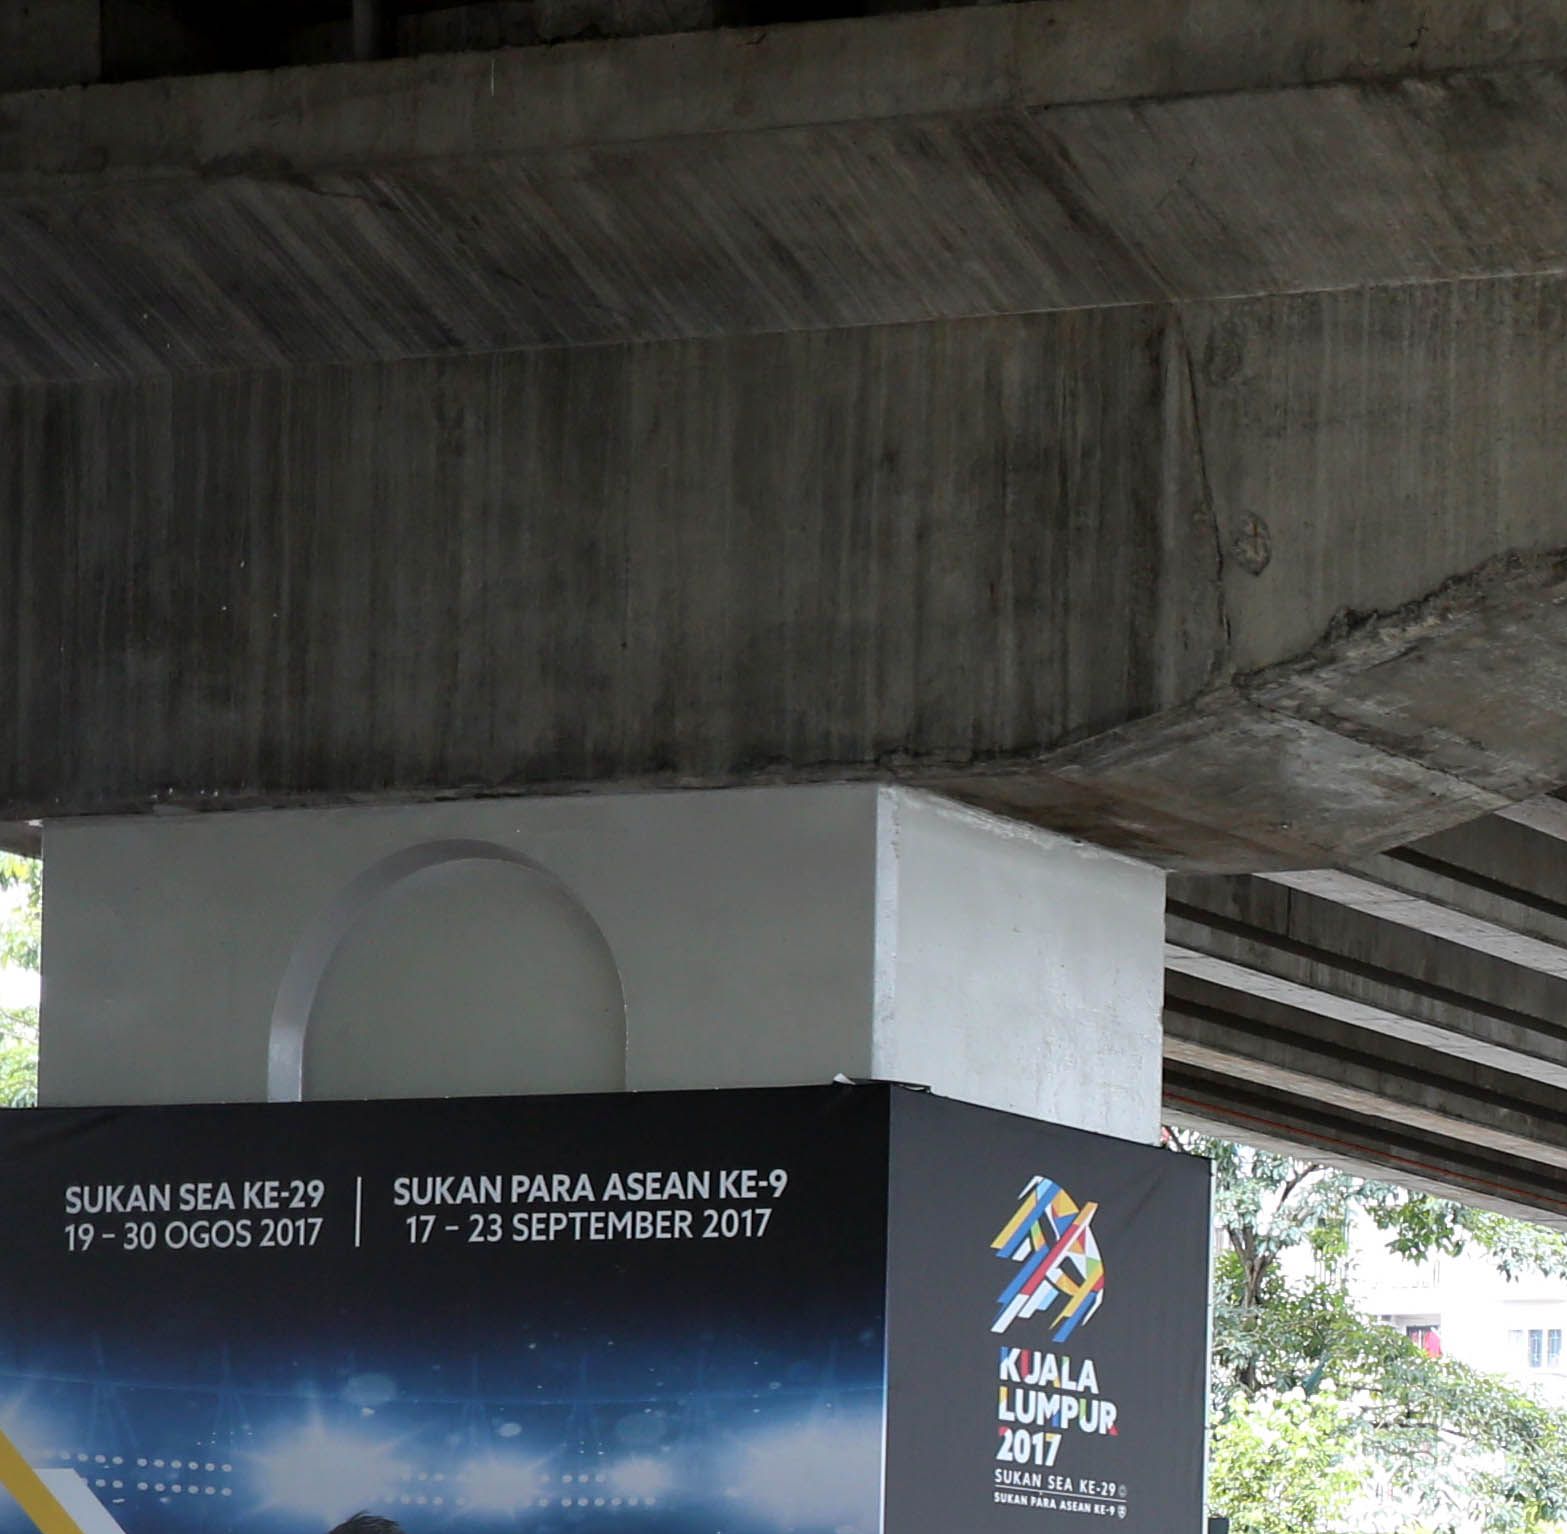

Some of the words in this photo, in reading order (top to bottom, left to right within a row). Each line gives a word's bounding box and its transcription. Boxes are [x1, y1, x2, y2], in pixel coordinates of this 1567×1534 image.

[65, 1183, 171, 1214] SUKAN
[179, 1182, 235, 1211] SEA
[243, 1179, 325, 1210] KE-29
[394, 1176, 502, 1206] SUKAN
[511, 1173, 595, 1203] PARA
[601, 1171, 710, 1201] ASEAN
[719, 1169, 788, 1199] KE-9
[64, 1223, 94, 1252] 19
[123, 1222, 157, 1250] 30
[164, 1219, 252, 1249] OGOS
[259, 1217, 324, 1248] 2017
[406, 1215, 436, 1243] 17
[468, 1213, 503, 1242] 23
[512, 1209, 693, 1242] SEPTEMBER
[702, 1208, 772, 1238] 2017
[1000, 1346, 1099, 1394] KUALA
[998, 1386, 1119, 1436] LUMPUR
[996, 1426, 1062, 1467] 2017
[995, 1468, 1042, 1488] SUKAN
[1048, 1475, 1073, 1492] SEA
[1079, 1480, 1117, 1497] KE-29
[994, 1491, 1029, 1506] SUKAN
[1031, 1496, 1057, 1509] PARA
[1059, 1501, 1091, 1513] ASEAN
[1094, 1504, 1115, 1515] KE-9
